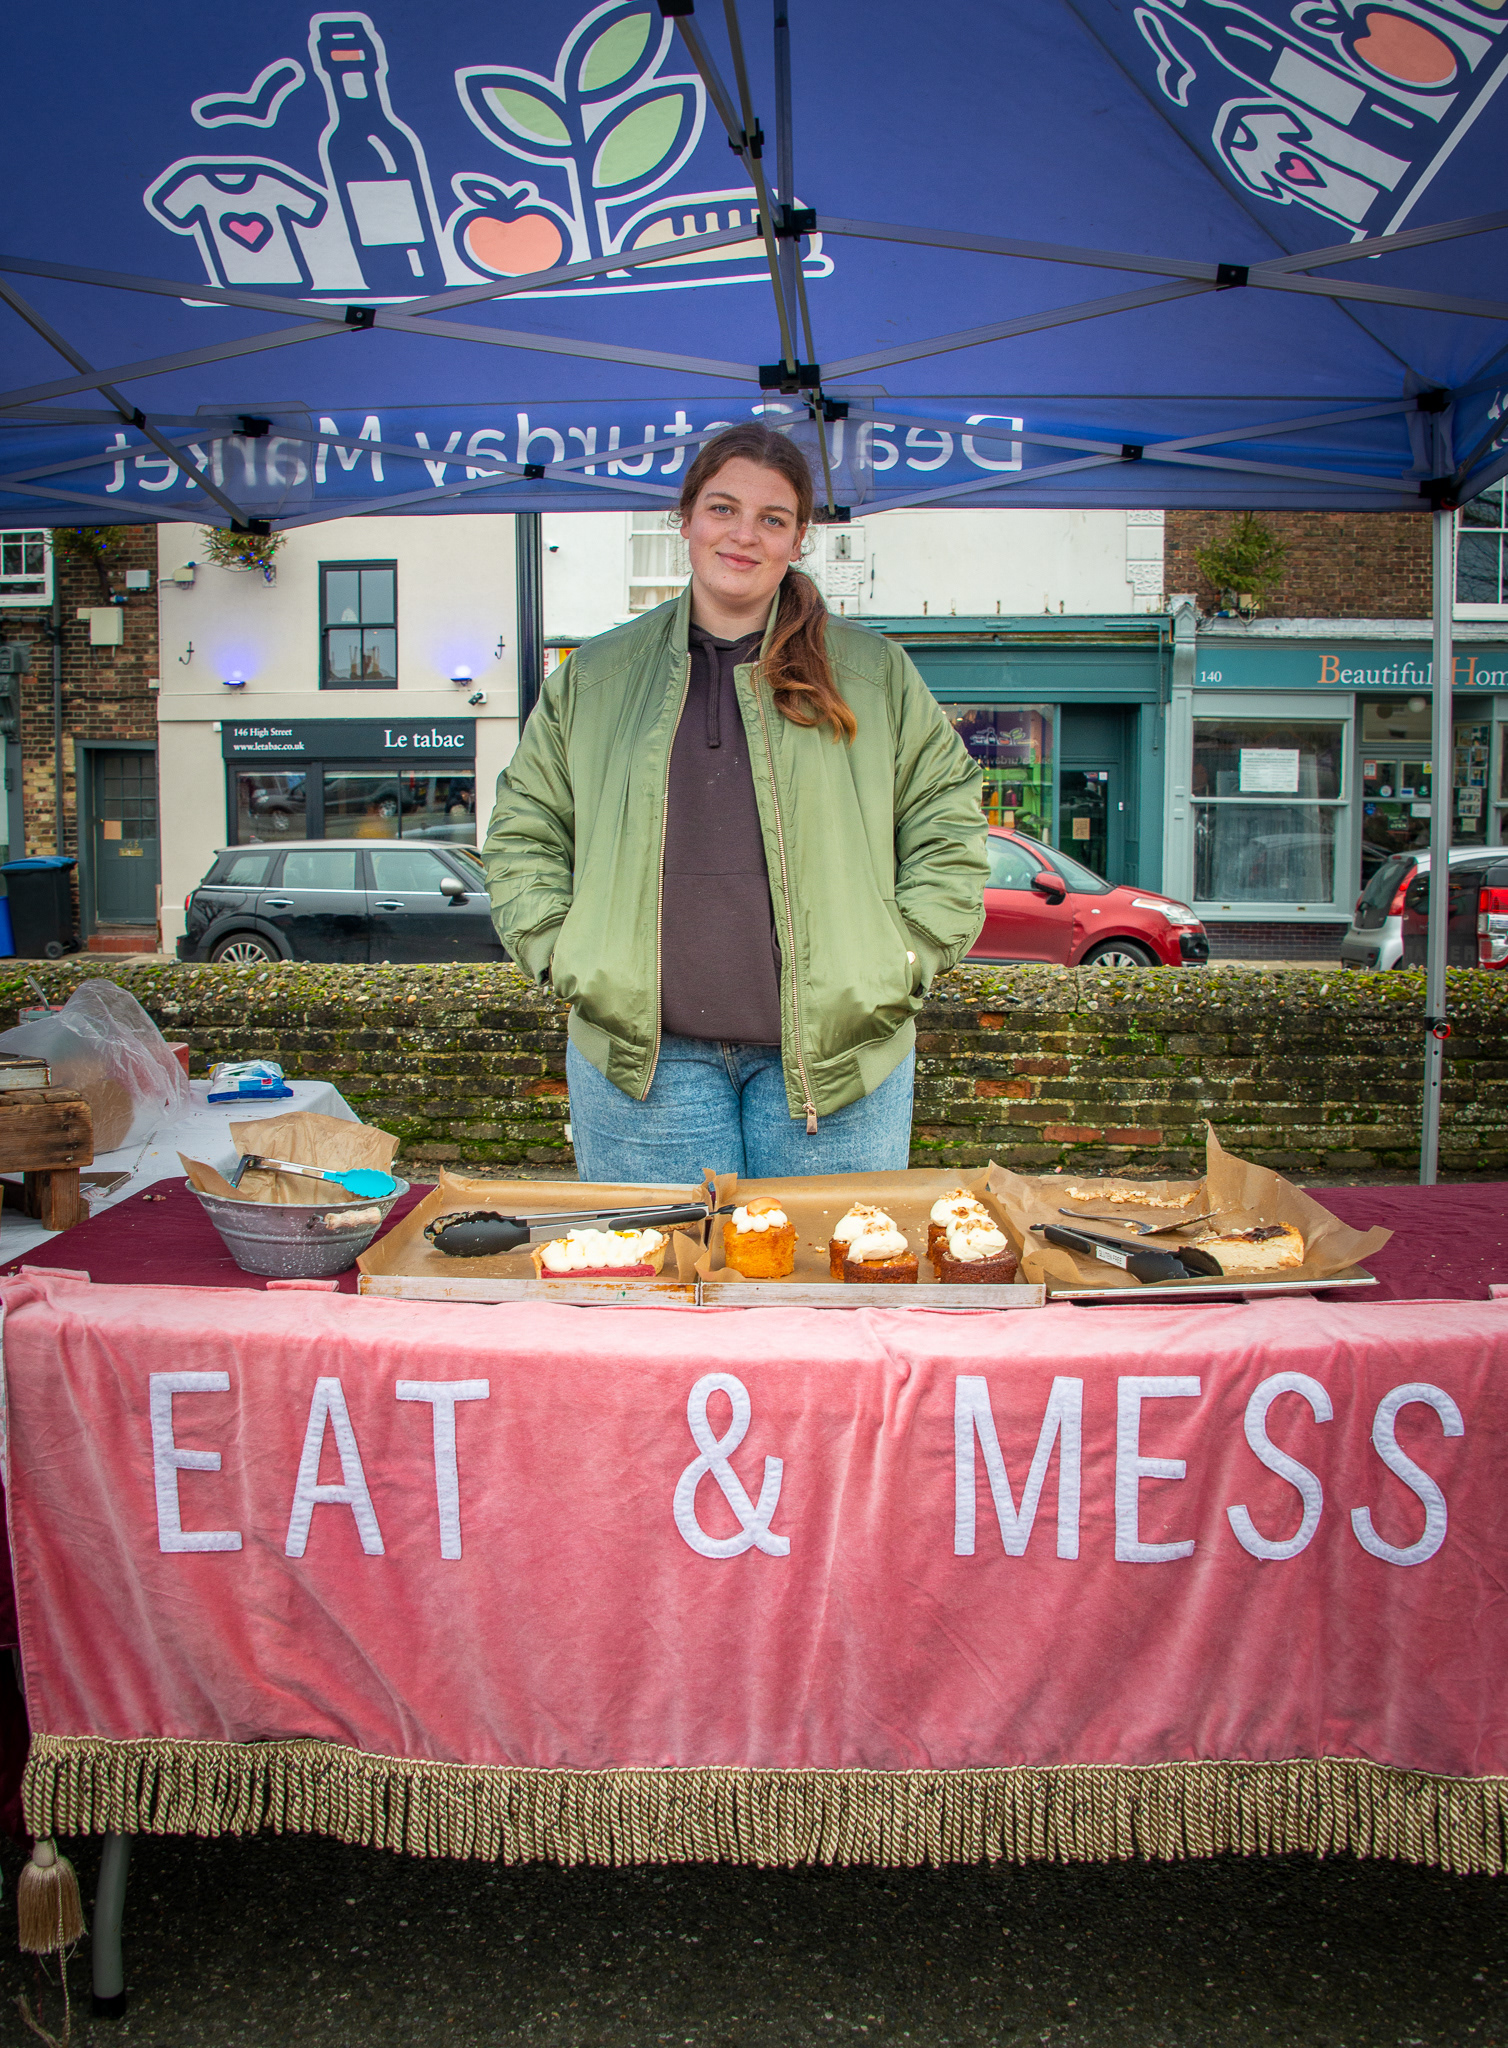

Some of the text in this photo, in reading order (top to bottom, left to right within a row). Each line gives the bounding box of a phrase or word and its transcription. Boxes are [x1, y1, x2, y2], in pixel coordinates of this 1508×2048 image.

[1199, 670, 1223, 683] 140
[1317, 655, 1433, 685] Beautiful
[234, 727, 293, 739] 146 High Street
[384, 728, 465, 749] Le tabac
[233, 741, 305, 751] www.letabac.co.uk
[148, 1371, 1465, 1566] EAT & MESS
